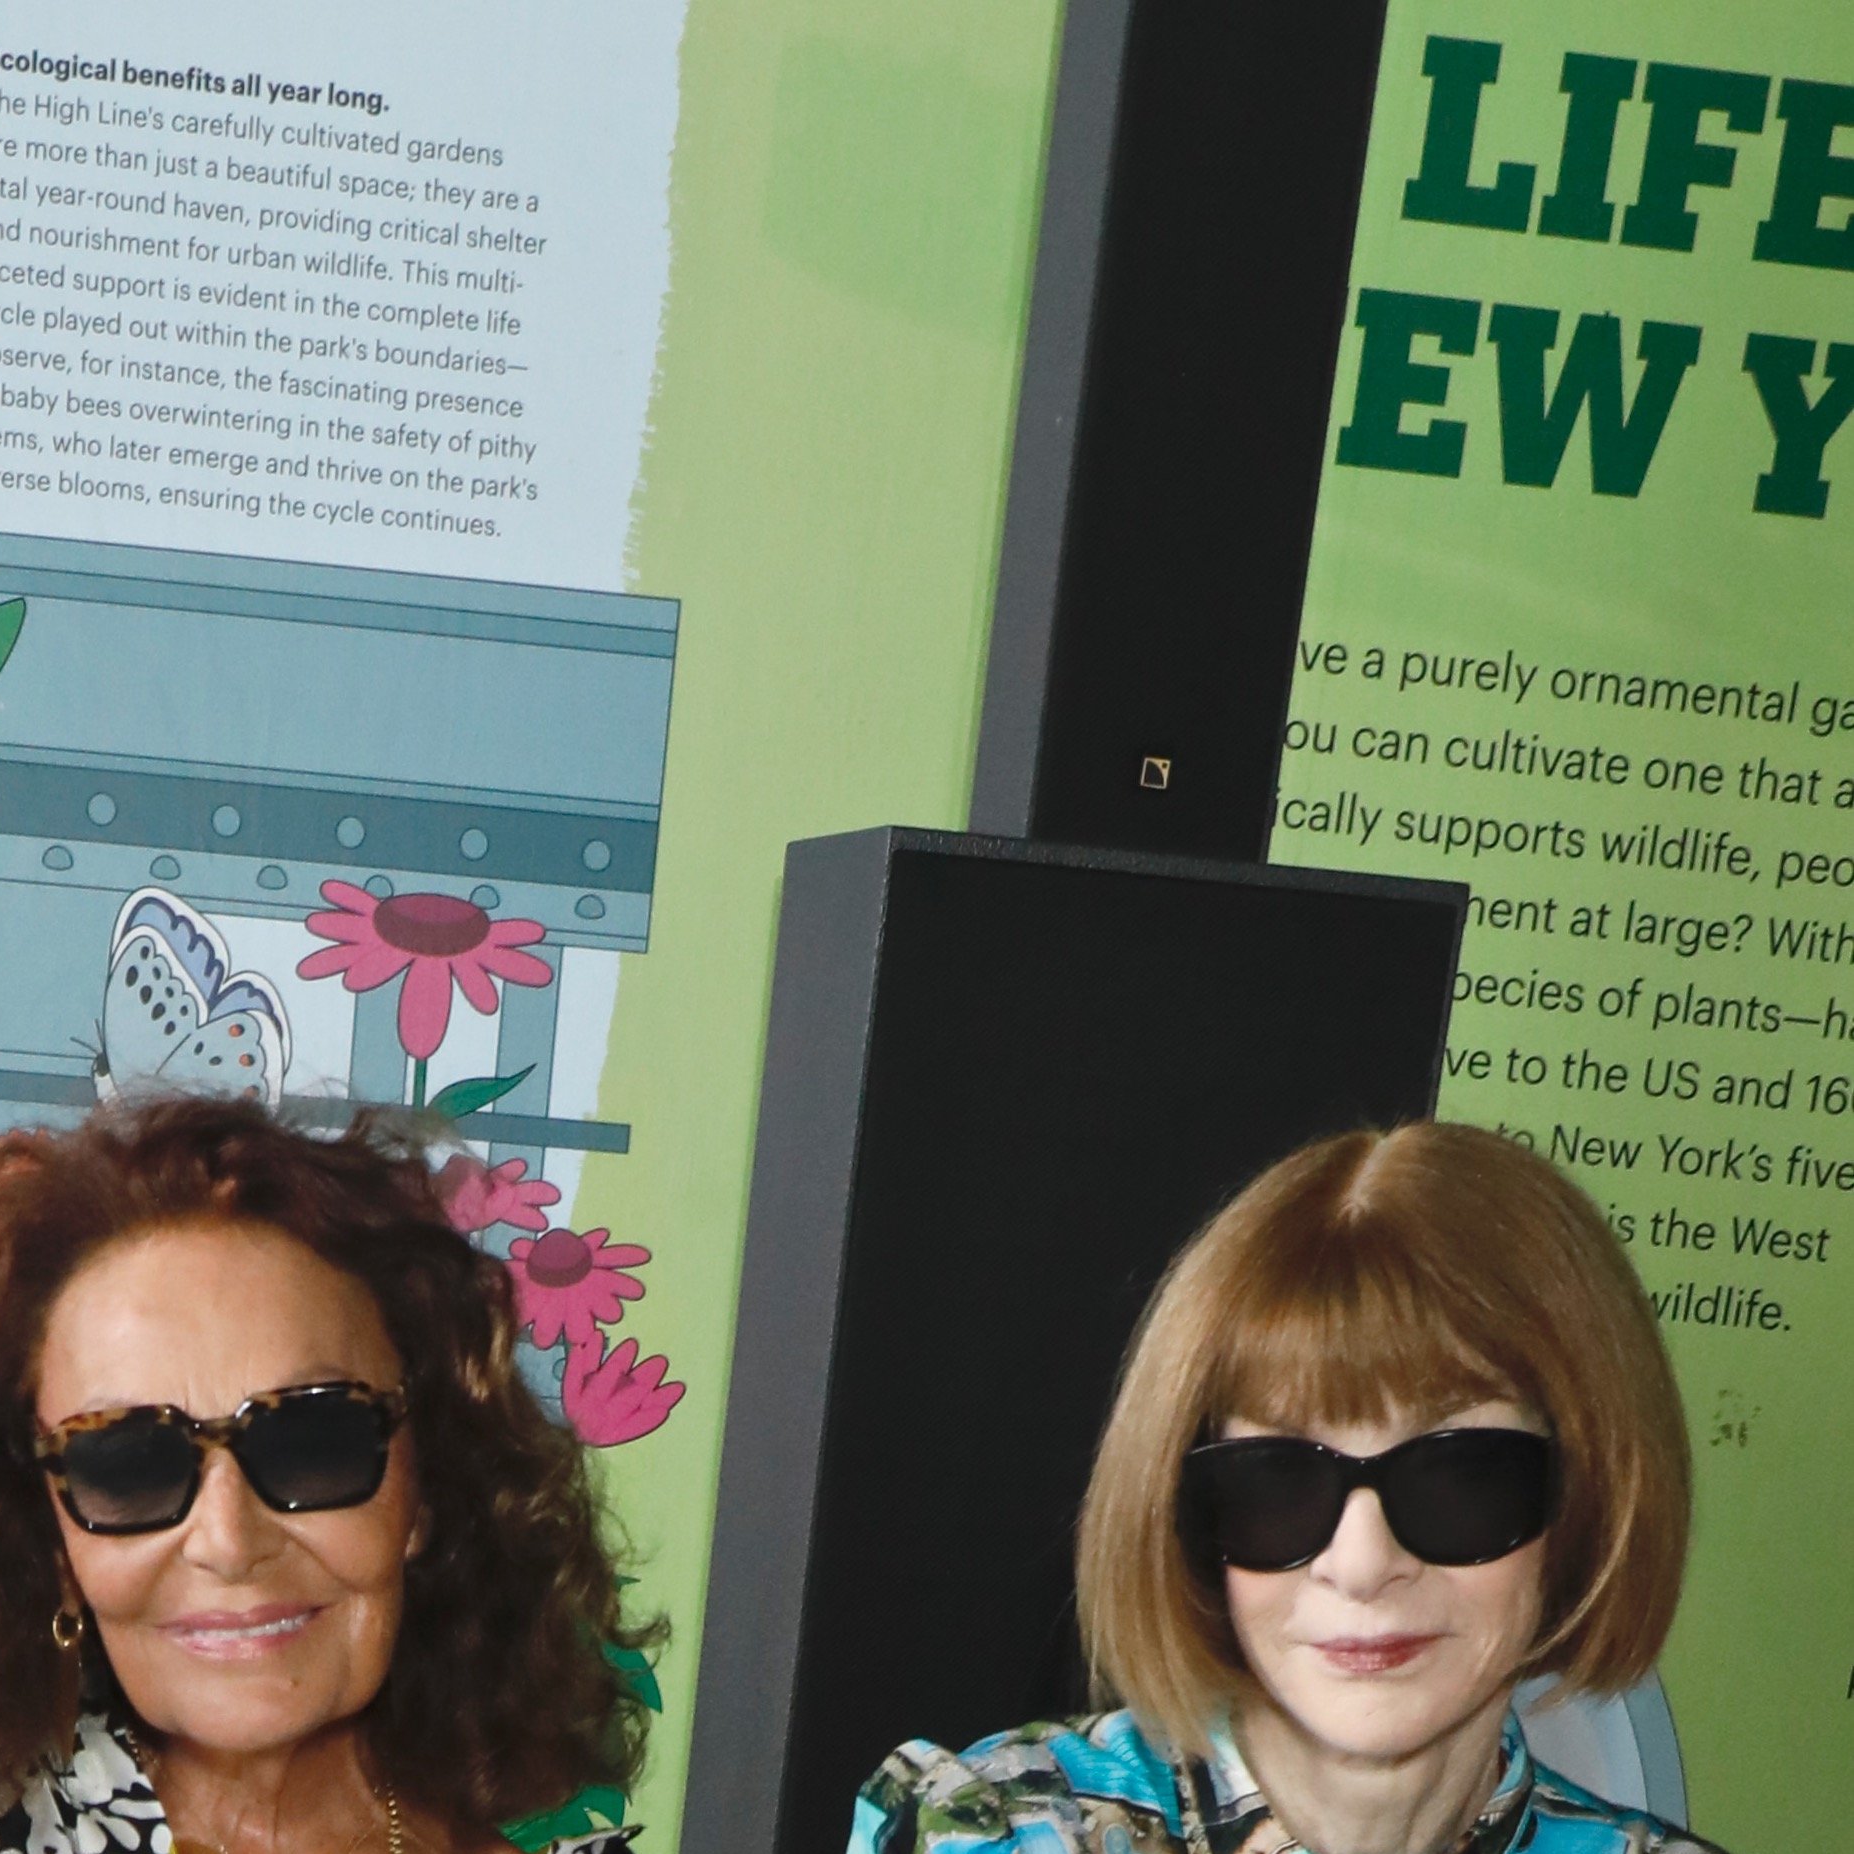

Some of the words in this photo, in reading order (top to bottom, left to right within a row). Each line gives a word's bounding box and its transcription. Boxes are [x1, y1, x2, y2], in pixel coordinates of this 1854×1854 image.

[122, 59, 227, 94] benefits
[231, 72, 262, 98] all
[267, 81, 323, 105] year
[327, 81, 390, 117] long.
[34, 94, 90, 126] High
[99, 101, 165, 130] Line's
[171, 112, 275, 147] carefully
[281, 122, 400, 156] cultivated
[407, 138, 503, 167] gardens
[1401, 35, 1854, 271] LIFE
[26, 141, 88, 164] more
[95, 142, 148, 171] than
[154, 148, 199, 178] just
[205, 160, 218, 179] a
[227, 155, 331, 191] beautiful
[338, 174, 416, 203] space;
[424, 177, 476, 211] they
[482, 189, 520, 211] are
[526, 195, 539, 213] a
[35, 184, 166, 215] year-round
[174, 191, 251, 227] haven,
[259, 207, 372, 242] providing
[379, 217, 460, 246] critical
[466, 225, 547, 255] shelter
[29, 226, 180, 259] nourishment
[187, 235, 221, 263] for
[228, 242, 296, 271] urban
[304, 250, 393, 281] wildlife.
[402, 259, 449, 287] This
[456, 268, 523, 294] multi-
[73, 273, 165, 299] support
[173, 276, 191, 301] is
[198, 282, 287, 312] evident
[295, 288, 315, 314] in
[322, 292, 360, 319] the
[367, 303, 480, 332] complete
[487, 308, 521, 335] life
[43, 305, 122, 337] played
[129, 320, 168, 341] out
[175, 320, 247, 349] within
[255, 327, 293, 353] the
[299, 334, 368, 361] park's
[375, 338, 528, 375] boundaries—
[80, 349, 114, 376] for
[121, 354, 226, 391] instance,
[234, 366, 273, 392] the
[279, 368, 408, 411] fascinating
[415, 390, 524, 418] presence
[1, 382, 59, 416] baby
[66, 389, 122, 418] bees
[129, 402, 292, 440] overwintering
[300, 413, 320, 438] in
[327, 417, 365, 442] the
[371, 422, 442, 455] safety
[448, 429, 474, 454] of
[478, 433, 537, 465] pithy
[52, 430, 102, 457] who
[110, 434, 162, 462] later
[169, 447, 259, 476] emerge
[265, 454, 310, 478] and
[317, 456, 383, 485] thrive
[390, 470, 419, 489] on
[427, 466, 464, 493] the
[471, 475, 538, 503] park's
[59, 470, 151, 505] blooms,
[159, 487, 261, 518] ensuring
[269, 491, 307, 517] the
[313, 499, 374, 525] cycle
[381, 509, 501, 537] continues.
[1361, 648, 1385, 680] a
[1399, 649, 1539, 705] purely
[1550, 668, 1800, 724] ornamental
[1352, 727, 1429, 764] can
[1444, 729, 1630, 785] cultivate
[1643, 758, 1725, 796] one
[1739, 759, 1822, 806] that
[1270, 786, 1382, 846] cally
[1394, 810, 1586, 859] supports
[1601, 824, 1761, 883] wildlife,
[1569, 903, 1610, 940] at
[1623, 899, 1754, 958] large?
[1597, 977, 1645, 1019] of
[1652, 982, 1854, 1042] plants—h
[1506, 1048, 1547, 1085] to
[1562, 1048, 1629, 1094] the
[1643, 1058, 1701, 1101] US
[1712, 1068, 1795, 1110] and
[1806, 1074, 1854, 1116] 16
[1548, 1124, 1643, 1172] New
[1786, 1145, 1854, 1192] five
[1650, 1207, 1716, 1251] the
[1732, 1216, 1831, 1263] West
